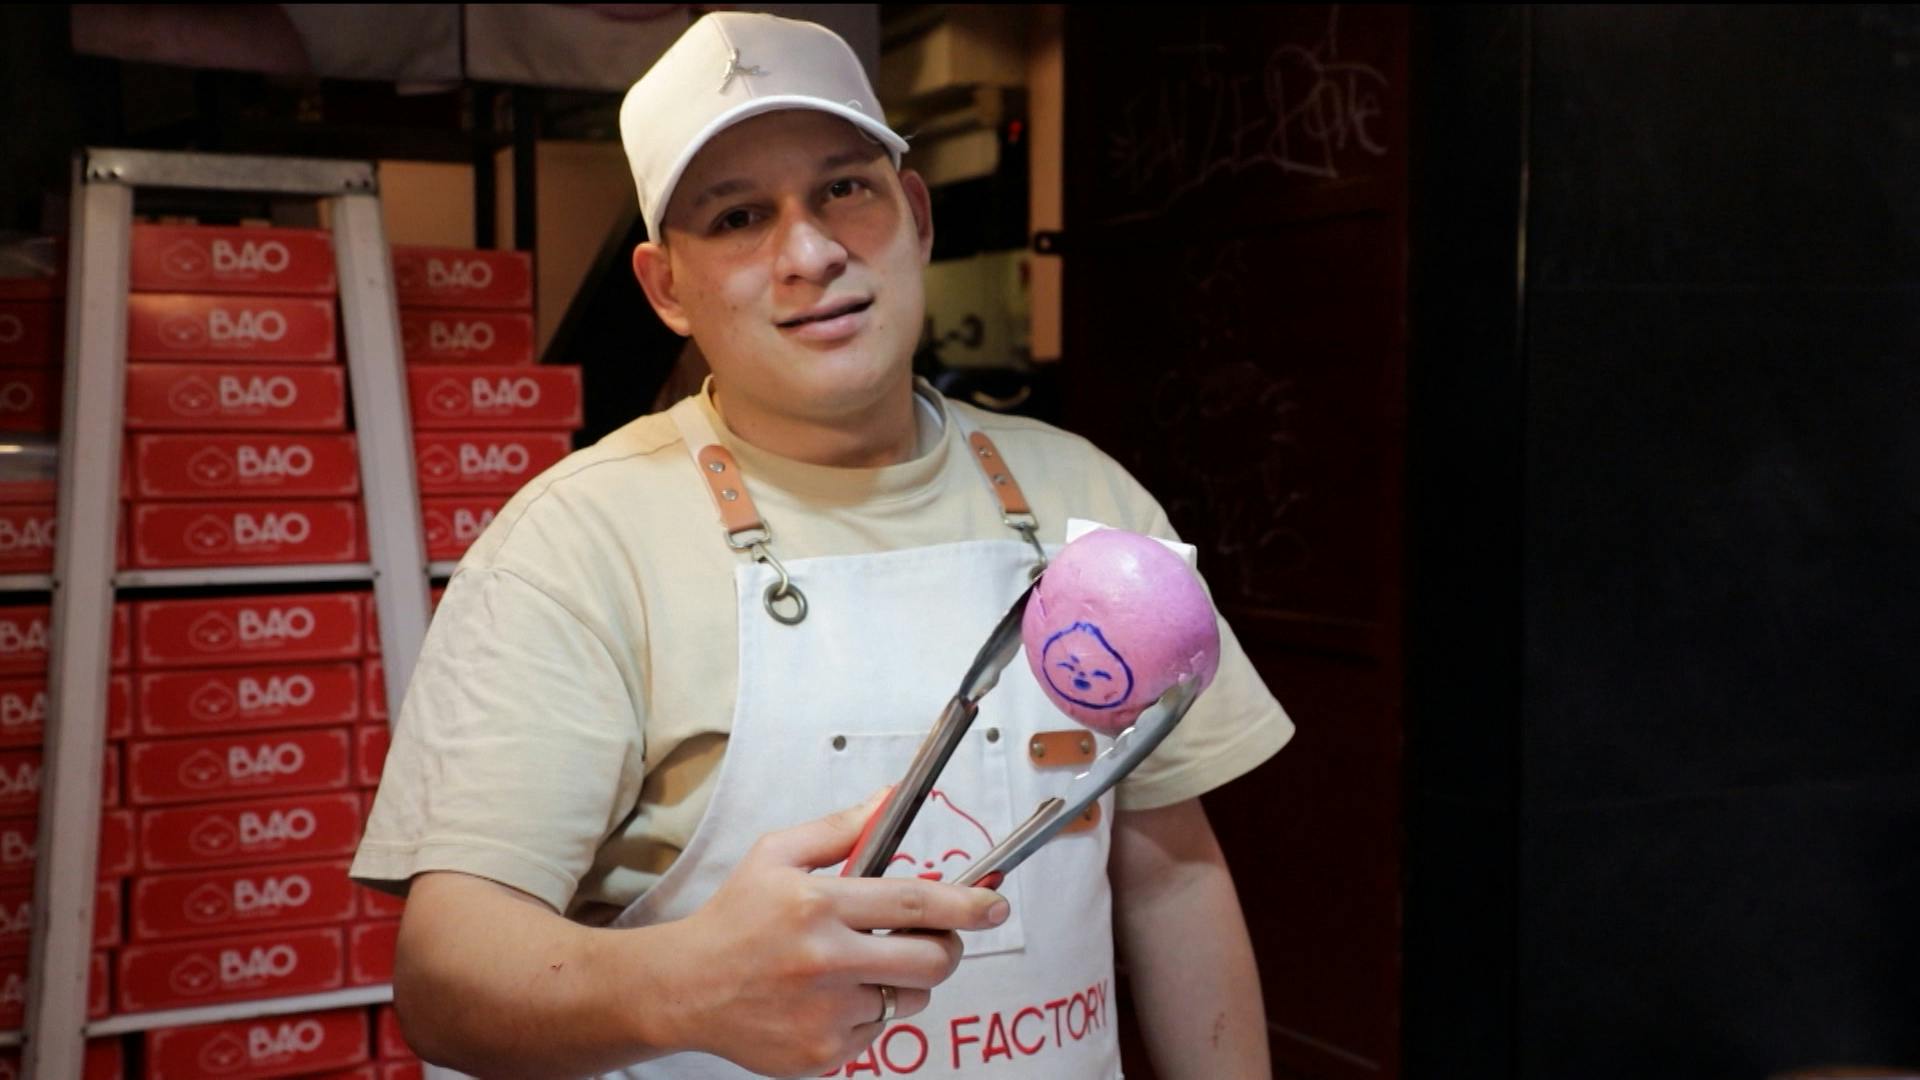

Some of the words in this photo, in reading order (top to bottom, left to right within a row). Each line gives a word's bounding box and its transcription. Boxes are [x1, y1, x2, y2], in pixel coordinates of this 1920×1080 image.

[213, 240, 289, 272] BAO
[428, 259, 492, 288] BAO
[209, 308, 286, 341] BAO
[431, 322, 494, 350] BAO
[219, 375, 297, 408] BAO
[472, 378, 539, 408] BAO
[237, 445, 313, 477] BAO
[460, 445, 528, 474] BAO
[234, 512, 309, 545] BAO
[0, 618, 50, 652] BA
[239, 606, 315, 641] BAO
[239, 675, 314, 709] BAO
[229, 742, 303, 778] BAO
[240, 809, 315, 843] BAO
[234, 875, 310, 911] BAO
[220, 945, 297, 982] BAO
[249, 1020, 323, 1059] BAO
[950, 978, 1109, 1070] FACTORY
